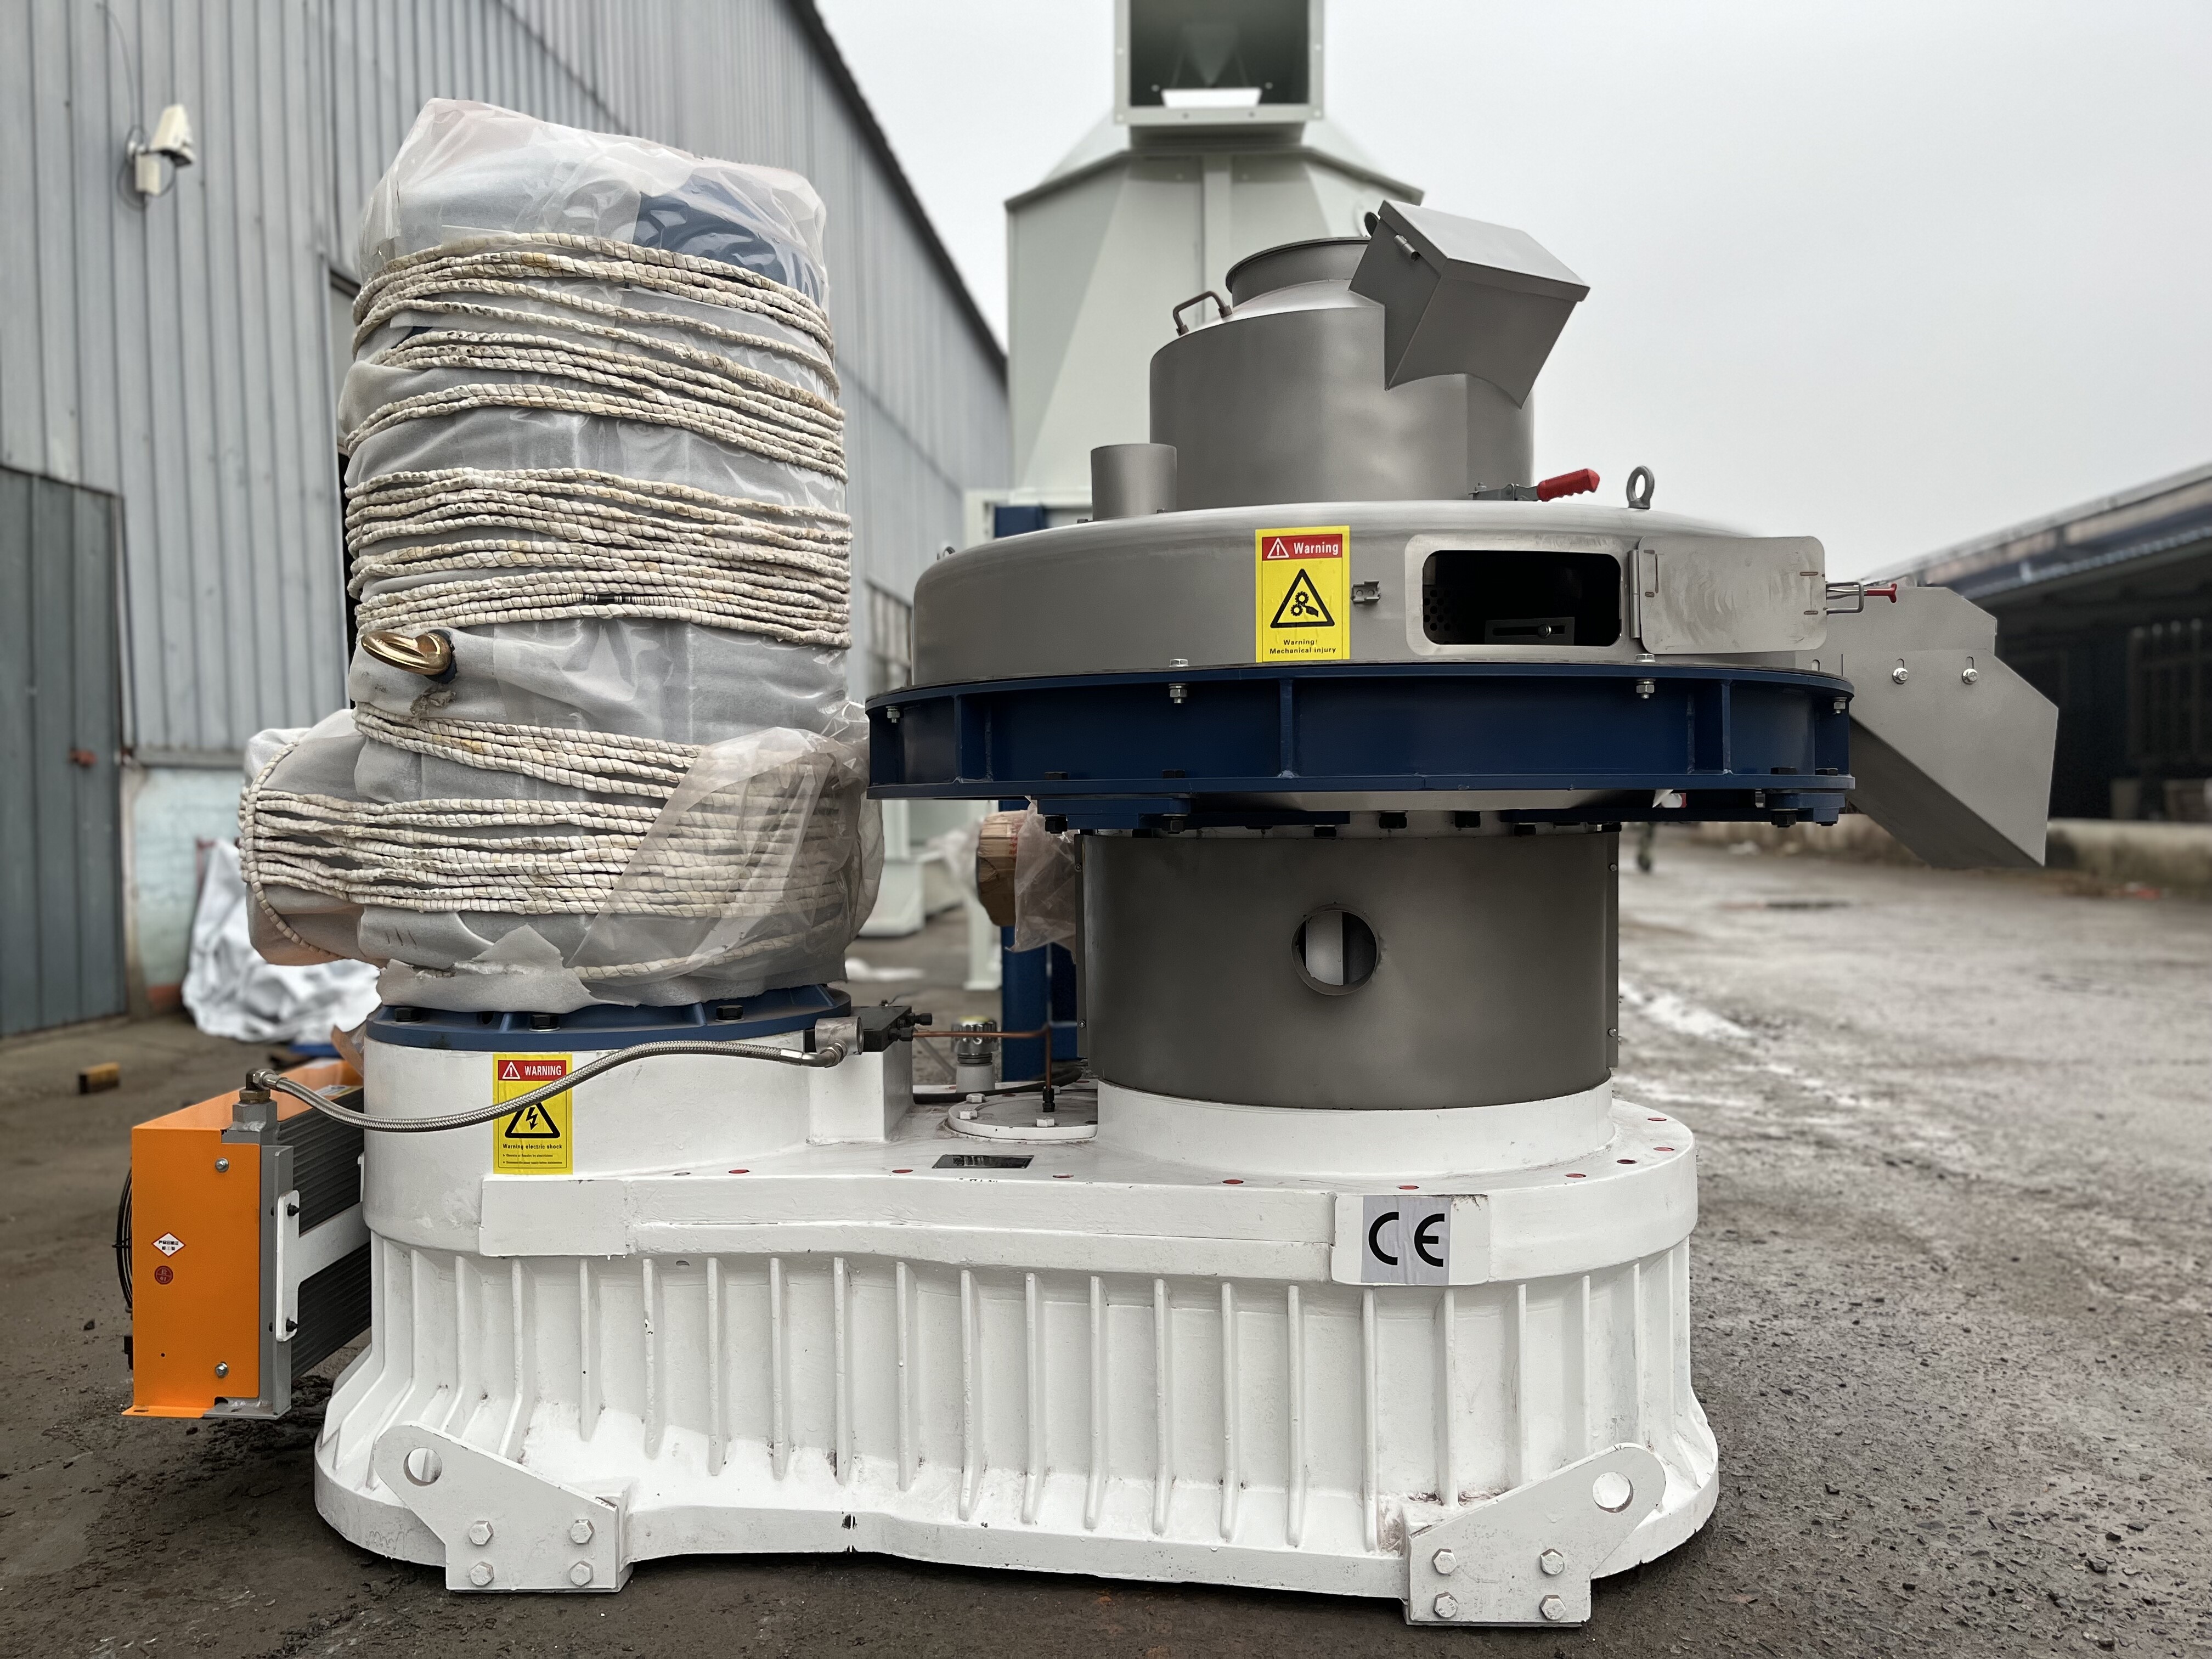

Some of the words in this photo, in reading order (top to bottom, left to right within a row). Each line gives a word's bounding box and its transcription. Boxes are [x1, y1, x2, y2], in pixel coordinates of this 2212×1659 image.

[1294, 541, 1339, 556] Warning
[524, 1065, 562, 1076] WARNING
[1368, 1211, 1445, 1267] CE
